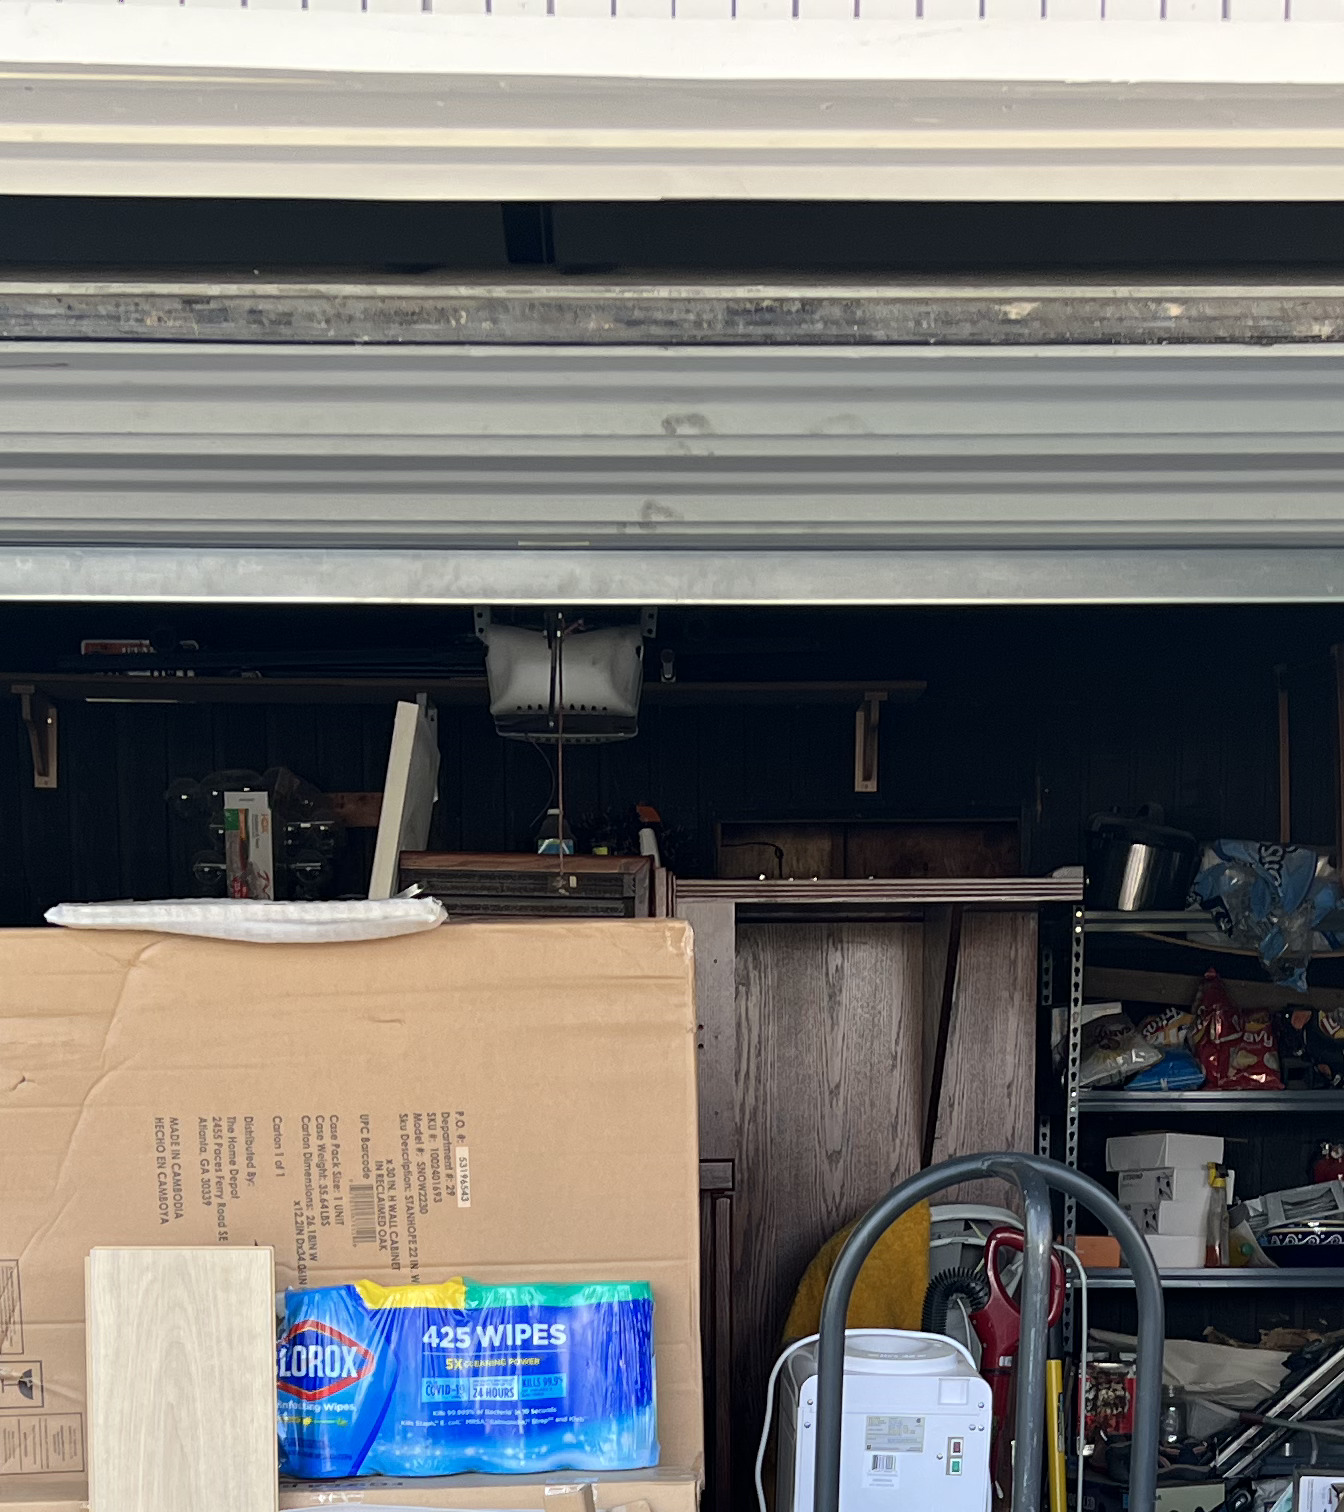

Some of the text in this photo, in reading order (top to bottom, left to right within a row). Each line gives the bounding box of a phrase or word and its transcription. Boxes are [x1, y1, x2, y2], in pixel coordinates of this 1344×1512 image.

[272, 1115, 283, 1150] Carton
[300, 1114, 312, 1150] Carton
[315, 1114, 326, 1141] Case
[329, 1114, 340, 1141] Case
[398, 1113, 409, 1132] Sku
[412, 1112, 425, 1145] Model
[426, 1112, 437, 1131] SKU
[243, 1116, 257, 1187] Distributed By:
[331, 1143, 342, 1169] Pack
[359, 1113, 373, 1180] UPC Barcode
[439, 1111, 454, 1171] Department
[154, 1117, 170, 1225] HECHO EN CAMBOYA
[169, 1116, 184, 1220] MADE IN CAMBODIA
[199, 1158, 210, 1175] GA
[226, 1115, 241, 1200] The Home Depot
[274, 1159, 285, 1170] of
[315, 1143, 329, 1181] Weight:
[385, 1166, 396, 1179] 30
[400, 1133, 414, 1193] Description:
[212, 1116, 229, 1242] 2455 Paces Ferry Road SE
[301, 1151, 315, 1211] Dimensions:
[331, 1170, 342, 1193] Size:
[416, 1161, 429, 1215] SNOW2230
[429, 1147, 443, 1204] 1002401693
[445, 1184, 456, 1197] 29
[458, 1155, 472, 1202] 53196543
[200, 1177, 213, 1207] 30339
[373, 1160, 388, 1252] IN RECLAIMED OAK
[333, 1204, 345, 1226] UNIT
[388, 1203, 398, 1230] WALL
[404, 1194, 418, 1246] STANHOPE
[308, 1252, 318, 1262] W
[389, 1230, 402, 1272] CABINET
[408, 1246, 419, 1259] 22
[410, 1273, 421, 1284] W
[422, 1323, 567, 1348] 425 WIPES
[276, 1344, 359, 1380] LOROX
[445, 1358, 463, 1370] 5X
[472, 1386, 515, 1399] 24 HOURS
[521, 1377, 541, 1388] KILLS
